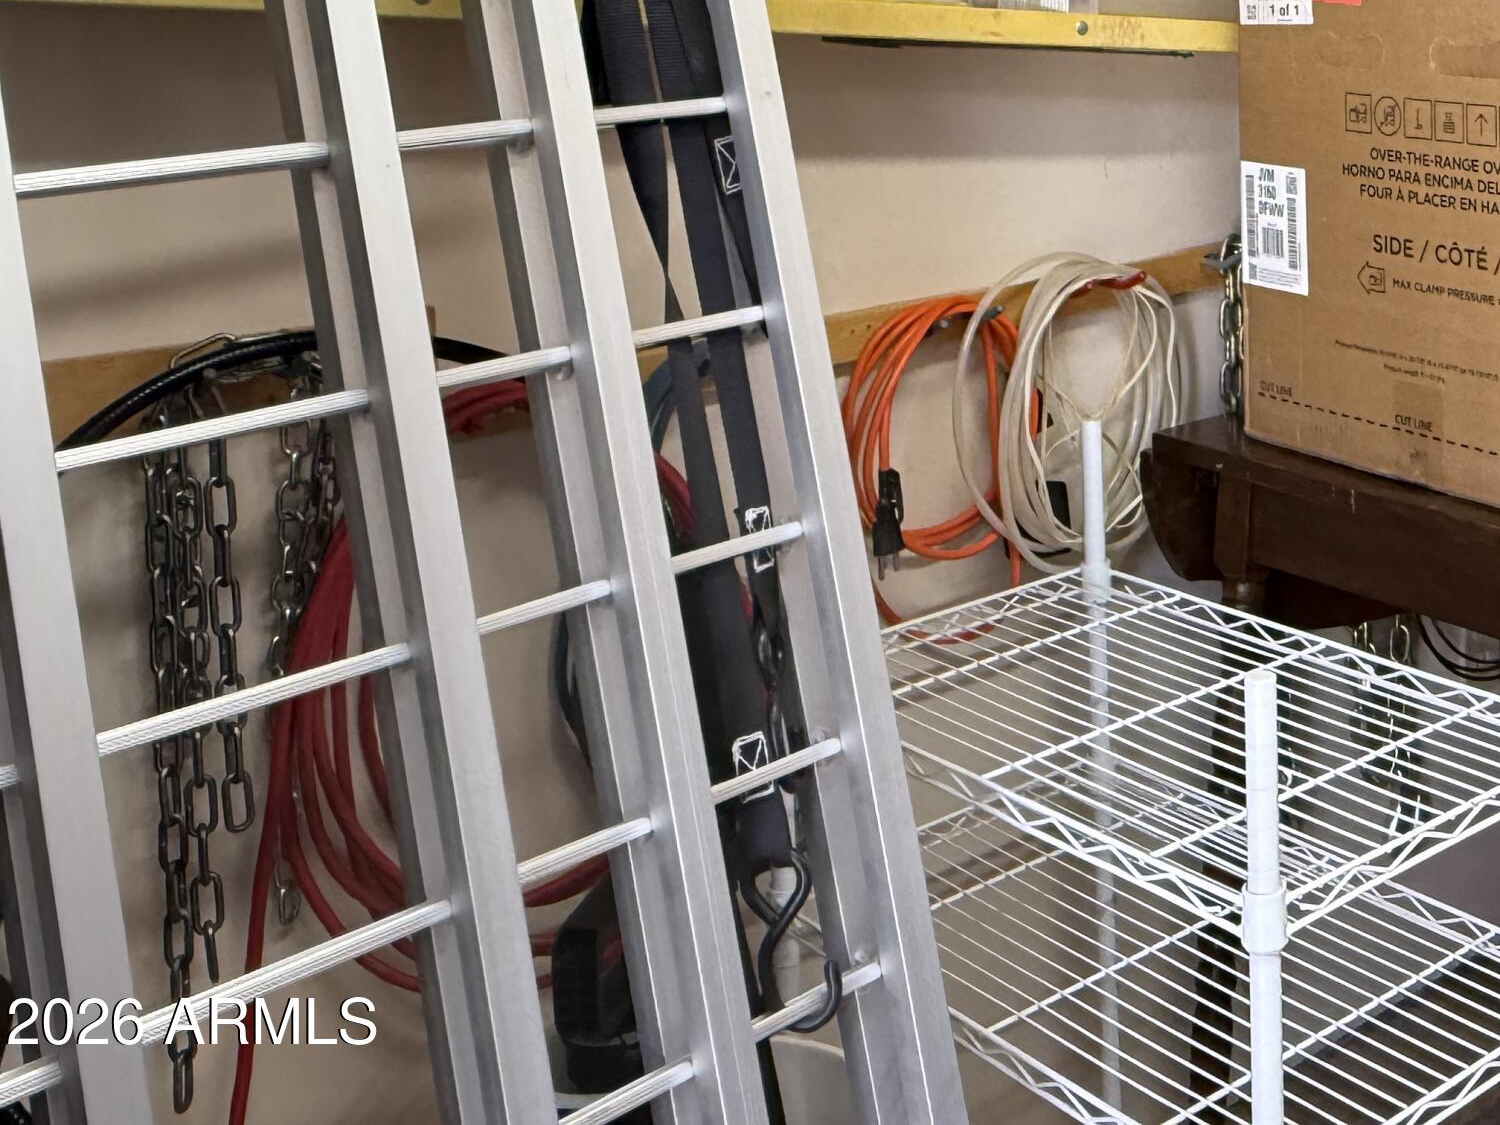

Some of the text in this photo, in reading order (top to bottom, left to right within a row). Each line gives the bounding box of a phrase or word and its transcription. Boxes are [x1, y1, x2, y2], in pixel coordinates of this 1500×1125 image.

[1269, 4, 1275, 16] 1
[1280, 3, 1290, 16] of
[1294, 4, 1299, 16] 1
[1370, 147, 1479, 173] OVER-THE-RANGE
[1342, 163, 1385, 180] HORNO
[1388, 169, 1421, 186] PARA
[1425, 173, 1474, 192] ENCIMA
[1360, 184, 1392, 200] FOUR
[1408, 190, 1456, 210] PLACER
[1460, 197, 1477, 213] EN
[1373, 234, 1415, 258] SIDE
[1418, 239, 1429, 263] /
[1435, 241, 1488, 271] CÔTÉ
[1395, 415, 1411, 427] CUT
